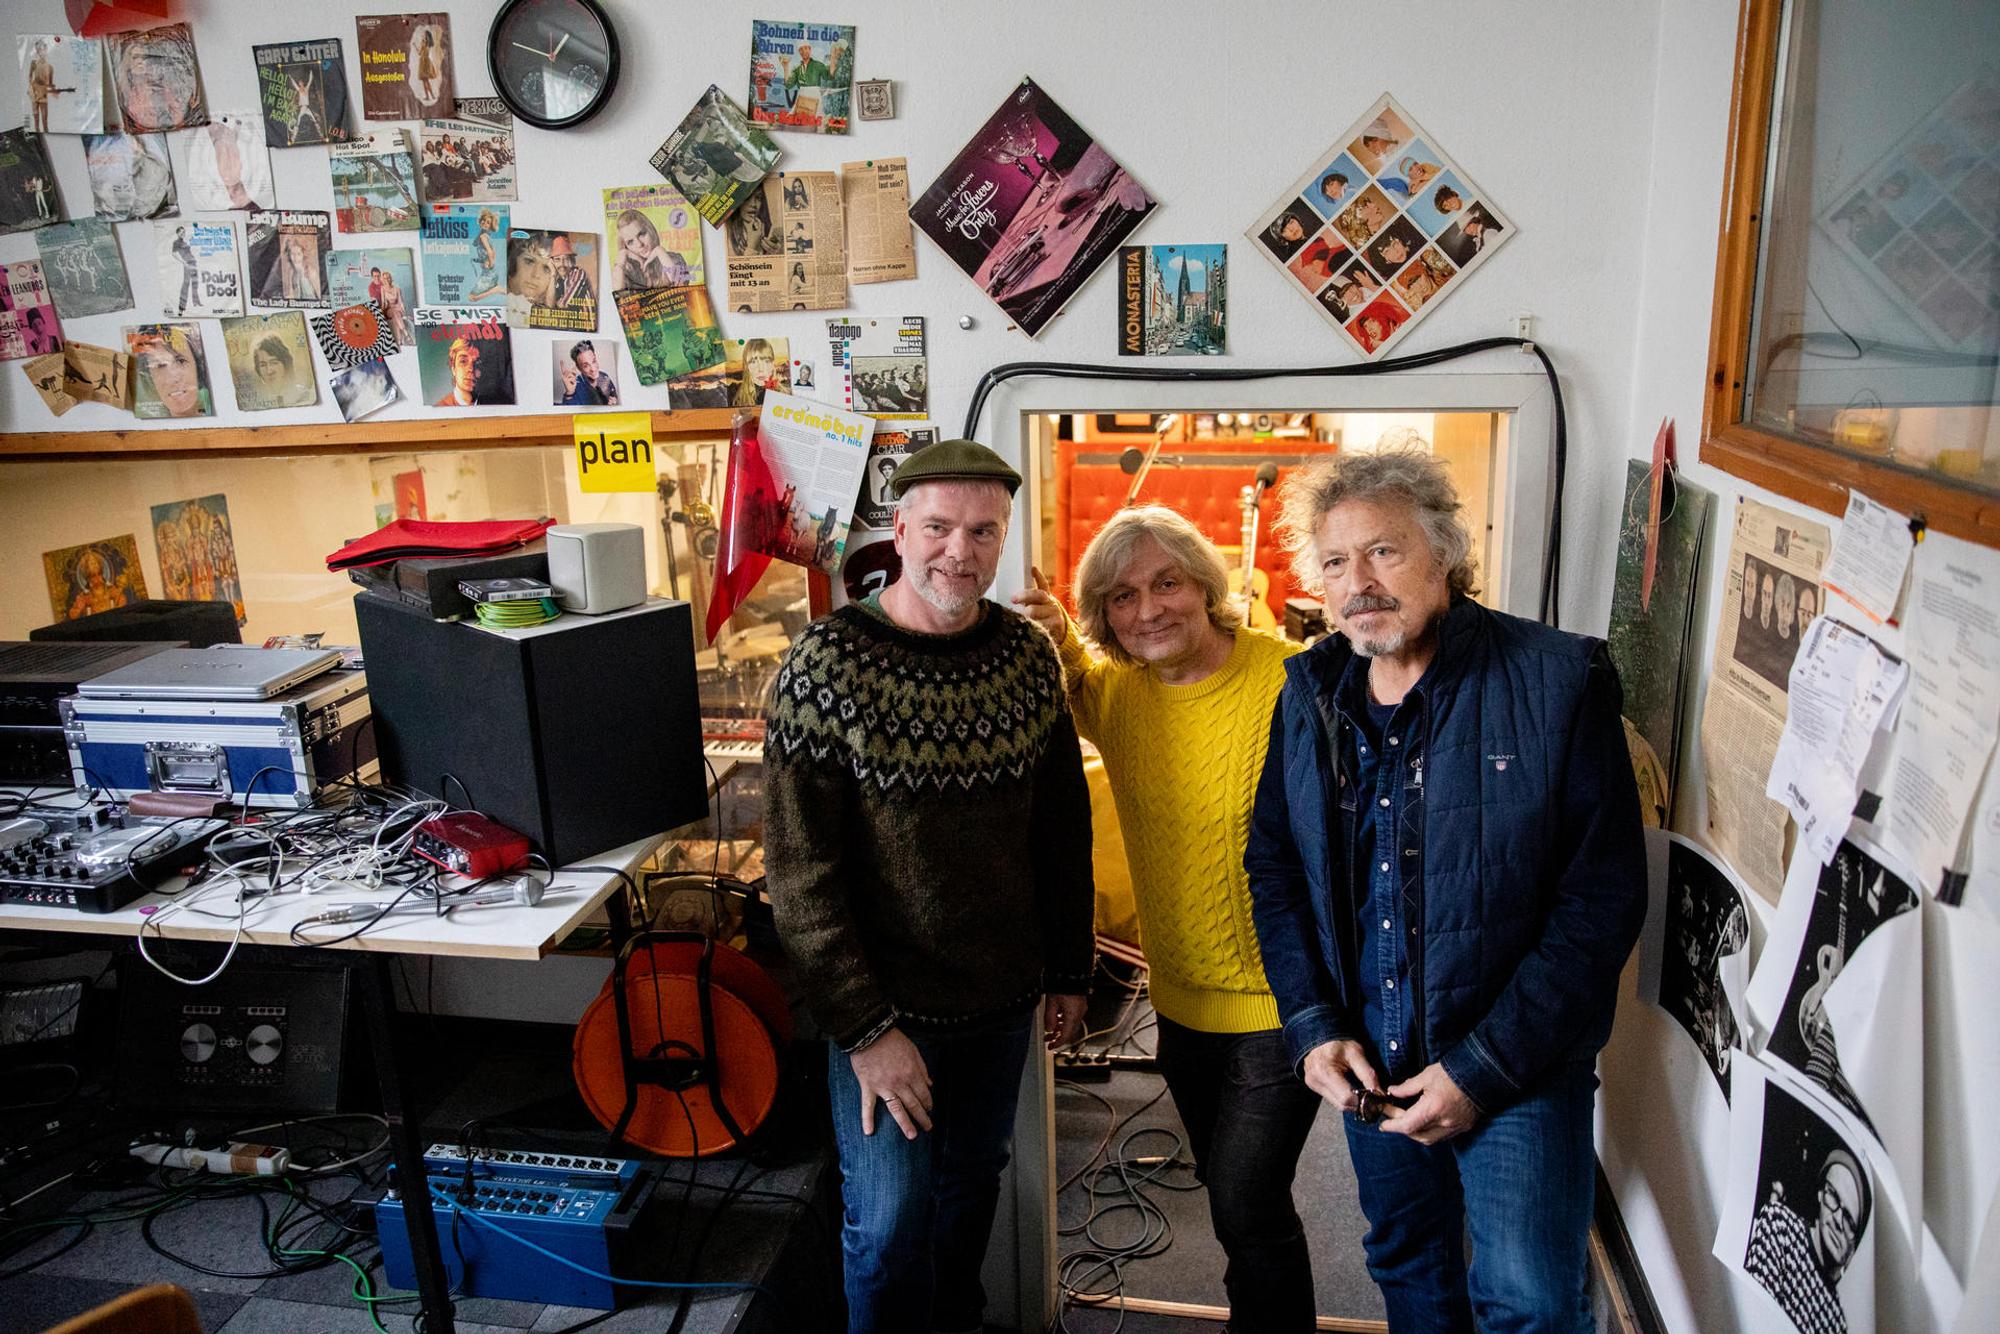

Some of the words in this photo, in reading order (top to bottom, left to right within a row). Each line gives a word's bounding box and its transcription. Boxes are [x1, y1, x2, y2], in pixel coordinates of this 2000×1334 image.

[758, 22, 804, 40] Bohnen
[807, 27, 819, 40] in
[821, 28, 839, 42] die
[758, 38, 794, 54] Ohren
[363, 51, 371, 64] In
[372, 49, 407, 65] Honolulu
[260, 66, 289, 84] HELLO!
[268, 83, 298, 99] HELLO!
[335, 143, 350, 151] Hot
[351, 140, 371, 151] Spot
[934, 196, 952, 217] JACKIE
[951, 172, 975, 198] GLEASON
[942, 209, 964, 233] Music
[958, 208, 997, 240] Only
[728, 262, 773, 271] Schönsein
[872, 264, 887, 272] ohne
[11, 279, 45, 296] LEANDROS
[206, 283, 238, 297] Door
[747, 280, 758, 288] 13
[269, 299, 288, 309] Lady
[1127, 250, 1142, 353] MONASTERIA
[416, 308, 442, 321] SE
[829, 324, 862, 341] dagogo
[772, 404, 864, 440] erdmöbel
[825, 431, 839, 441] no.
[848, 436, 863, 449] hits
[580, 433, 652, 474] plan
[877, 443, 906, 455] CLAIR
